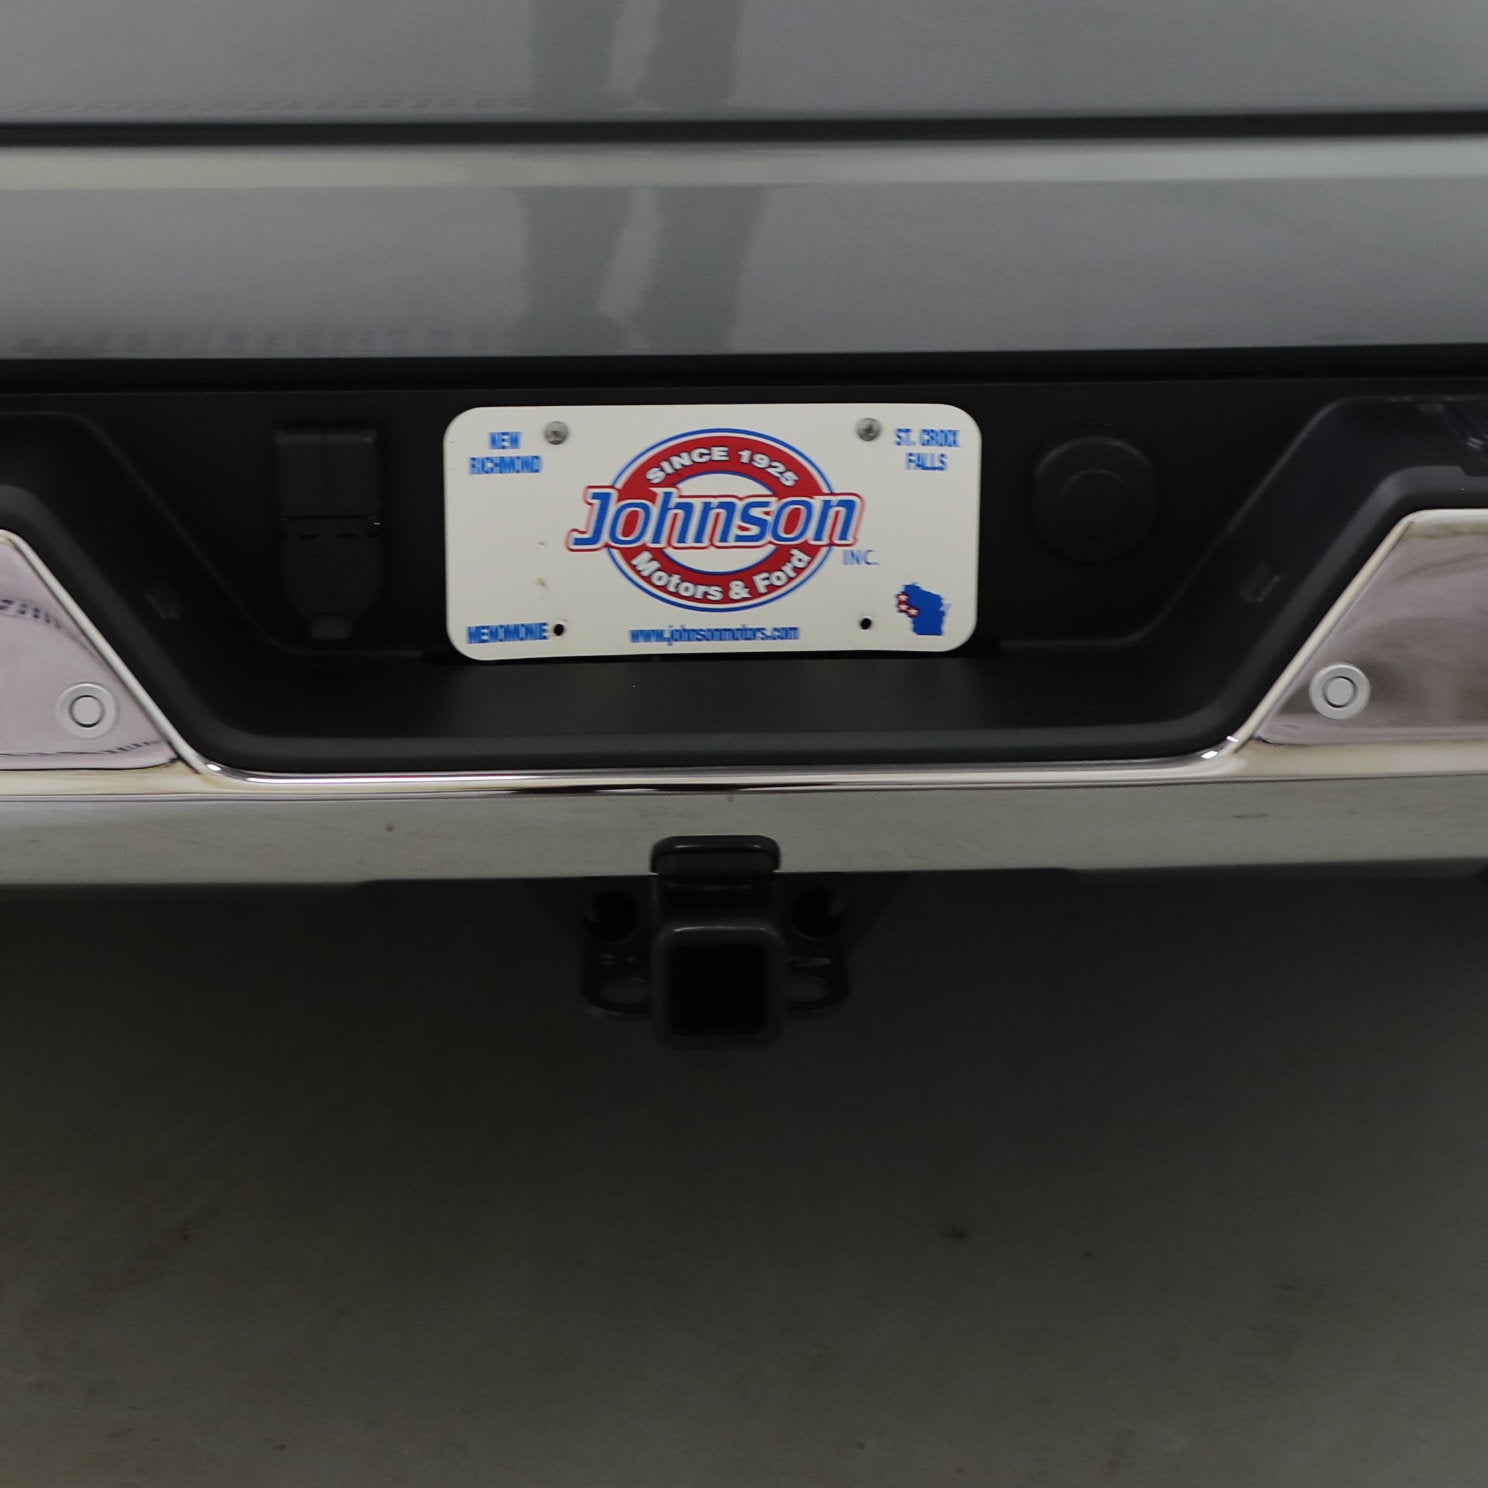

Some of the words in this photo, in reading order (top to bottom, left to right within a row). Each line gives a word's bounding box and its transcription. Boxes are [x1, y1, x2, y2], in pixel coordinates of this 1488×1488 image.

[488, 431, 522, 450] NEW
[894, 428, 916, 446] ST.
[919, 428, 961, 447] CROIX
[468, 455, 543, 475] RICHMOND
[644, 446, 730, 487] SINCE
[737, 448, 800, 489] 1925
[905, 452, 948, 471] FALLS
[570, 488, 860, 548] Johnson
[842, 549, 879, 566] INC.
[629, 550, 724, 602] Motors
[727, 580, 752, 602] &
[752, 548, 813, 596] Ford
[629, 624, 801, 646] www.johnsonmotors.com
